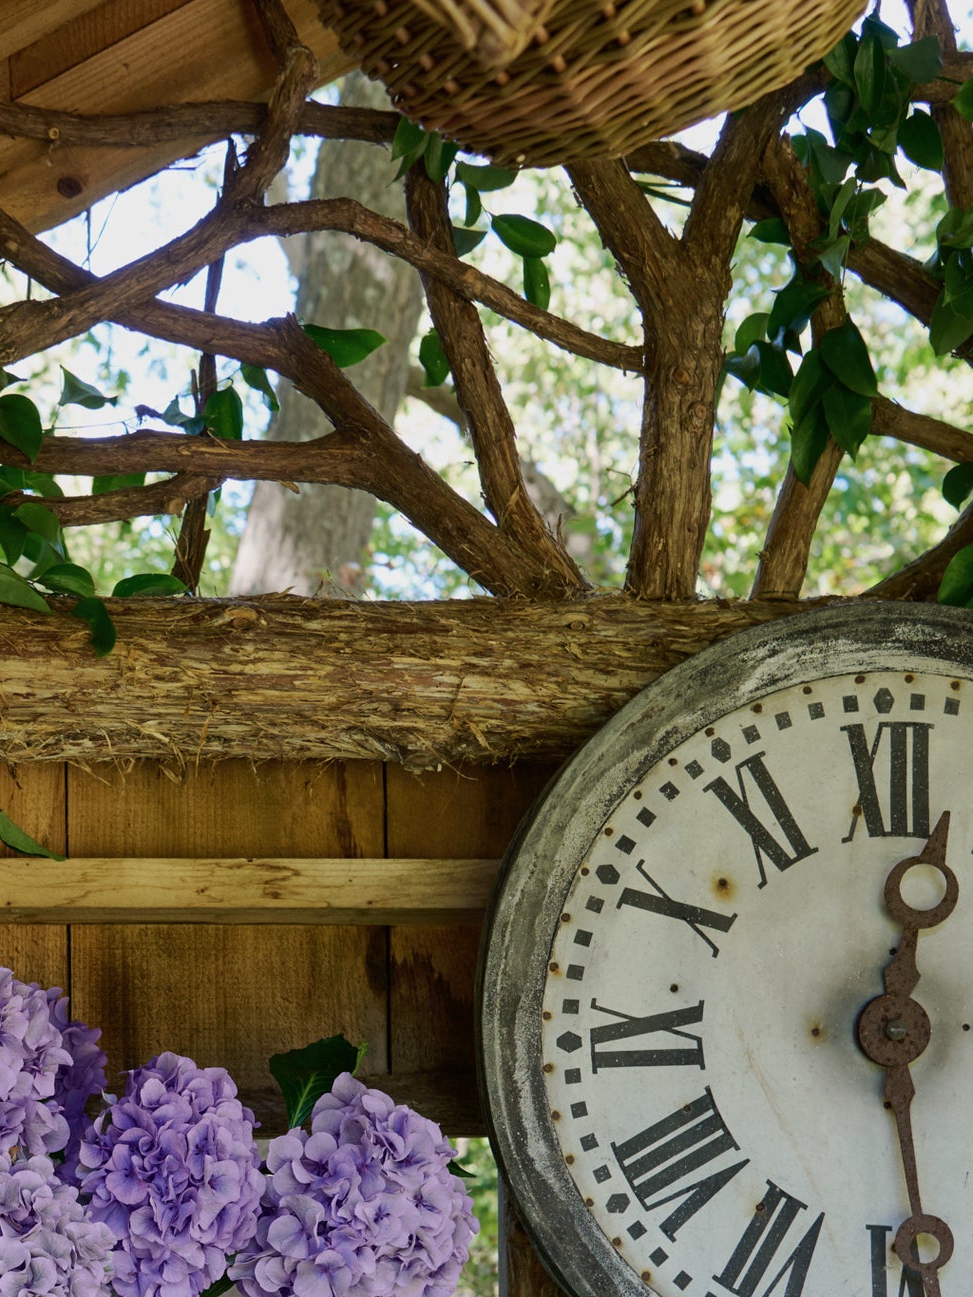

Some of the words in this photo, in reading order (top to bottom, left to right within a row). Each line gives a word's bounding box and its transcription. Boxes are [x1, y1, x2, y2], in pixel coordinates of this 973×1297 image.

[702, 750, 819, 890] XI
[840, 721, 935, 844] XII
[616, 858, 738, 958] X
[590, 998, 706, 1075] IX
[610, 1085, 751, 1243] VIII
